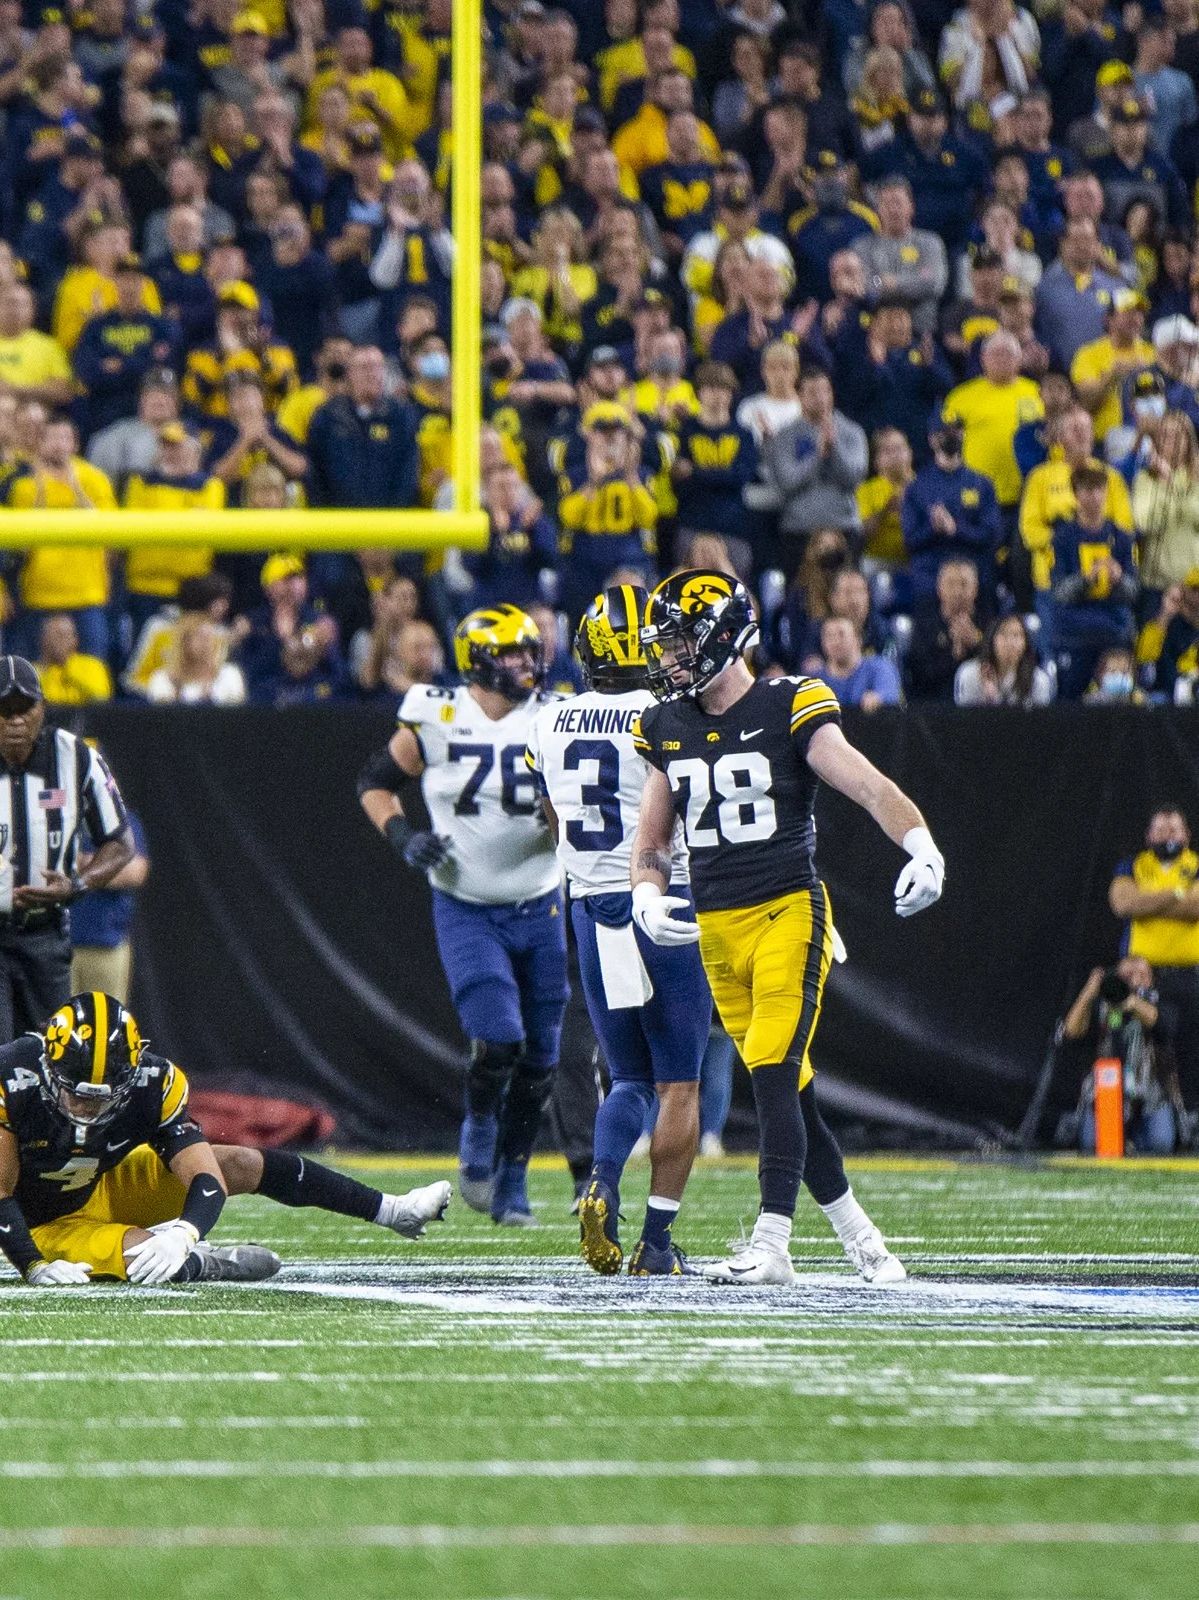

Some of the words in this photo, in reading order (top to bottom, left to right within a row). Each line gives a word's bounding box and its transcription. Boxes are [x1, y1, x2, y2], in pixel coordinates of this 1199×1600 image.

[553, 708, 642, 734] HENNING
[563, 739, 624, 851] 3
[666, 751, 778, 848] 28
[49, 830, 62, 849] U
[39, 1157, 100, 1192] 4
